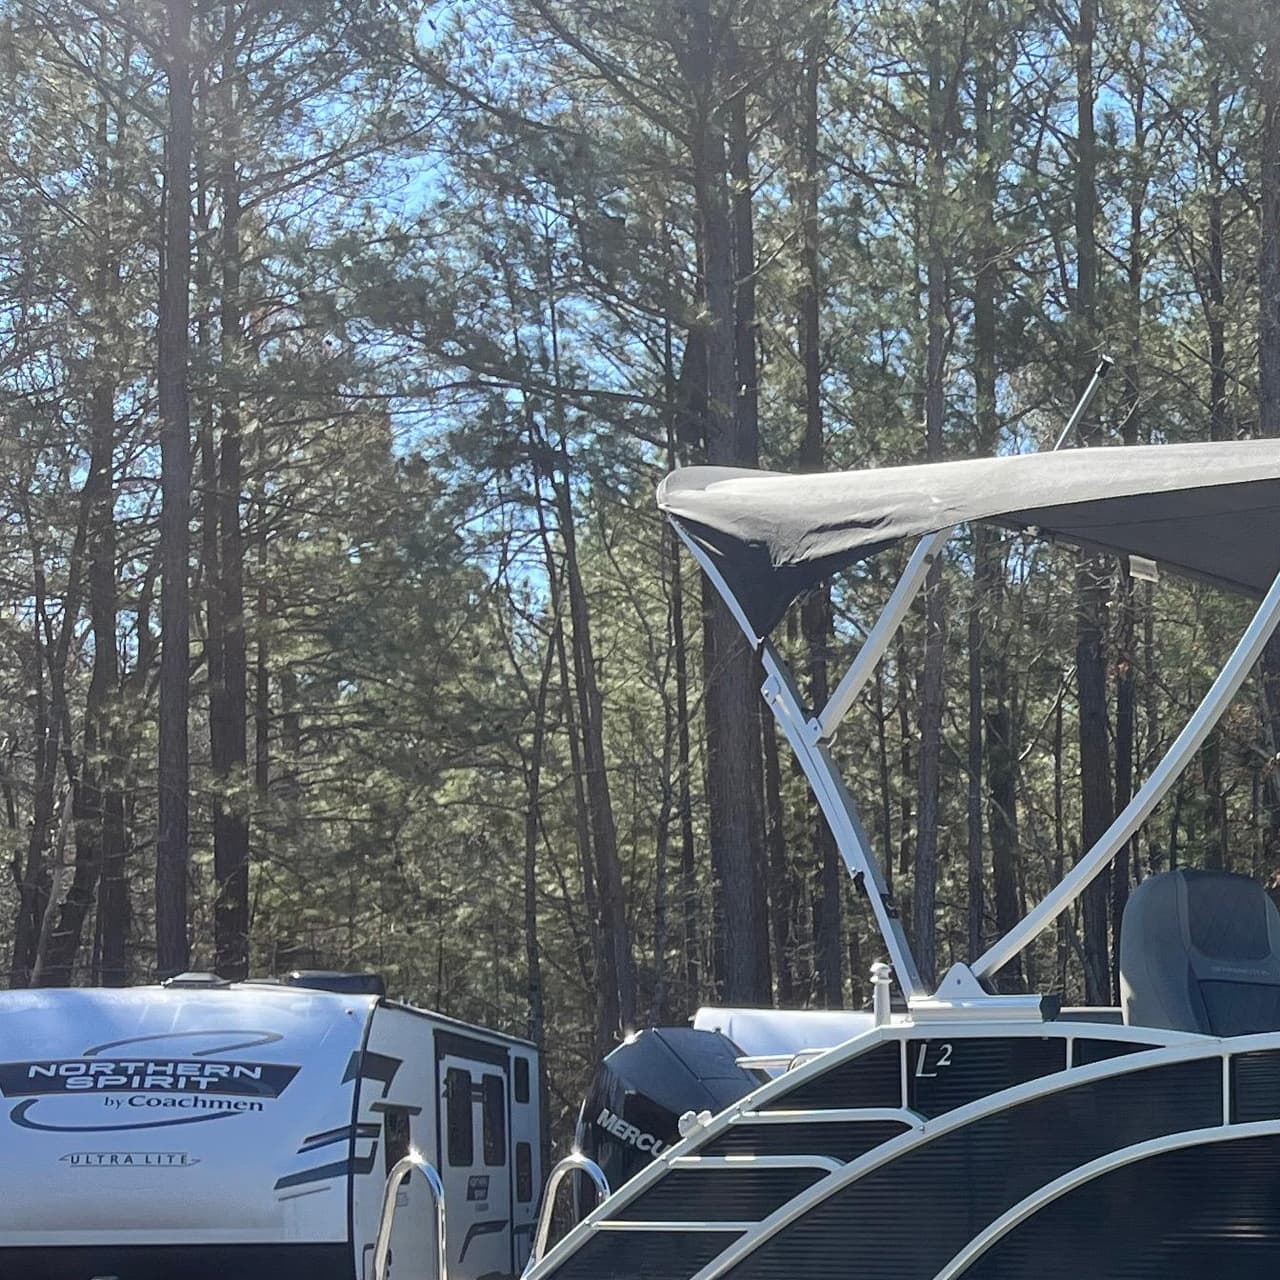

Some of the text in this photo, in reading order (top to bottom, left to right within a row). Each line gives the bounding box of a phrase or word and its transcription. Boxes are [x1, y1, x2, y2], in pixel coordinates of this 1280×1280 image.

[28, 1062, 262, 1080] NORTHERN
[65, 1075, 219, 1090] SPIRIT
[104, 1095, 264, 1112] by Coachmen
[70, 1153, 188, 1165] ULTRA LITE
